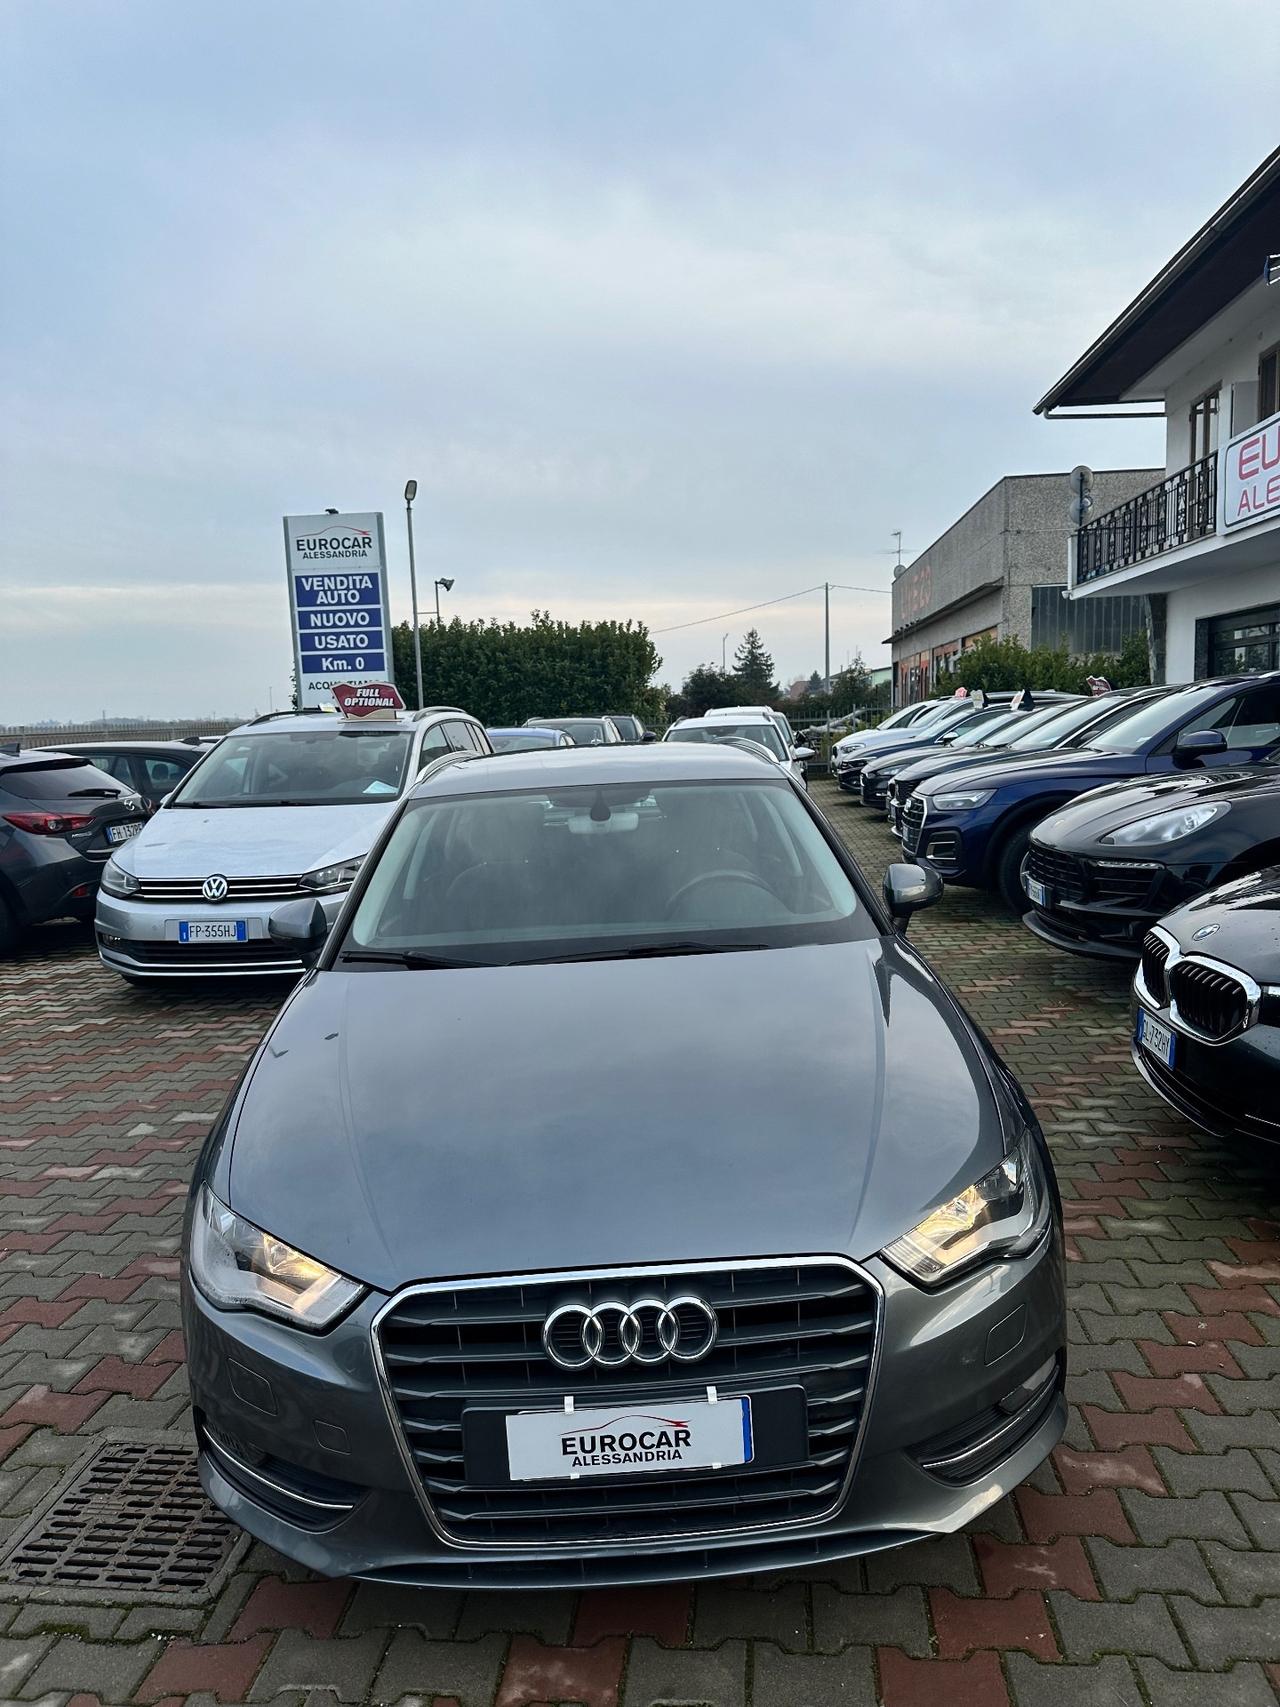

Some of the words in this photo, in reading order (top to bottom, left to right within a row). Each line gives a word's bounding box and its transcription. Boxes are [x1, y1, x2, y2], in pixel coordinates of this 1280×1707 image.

[296, 536, 372, 551] EUROCAR
[303, 549, 368, 560] ALESSANDRIA
[301, 575, 373, 591] VENDITA
[316, 590, 360, 604] AUTO
[310, 612, 370, 627] NUOVO
[314, 634, 369, 649] USATO
[321, 657, 352, 671] Km.
[355, 657, 365, 670] 0
[356, 688, 380, 697] FULL
[344, 698, 395, 707] OPTIONAL
[561, 1429, 692, 1456] EUROCAR
[571, 1449, 683, 1467] ALESSANDRIA
